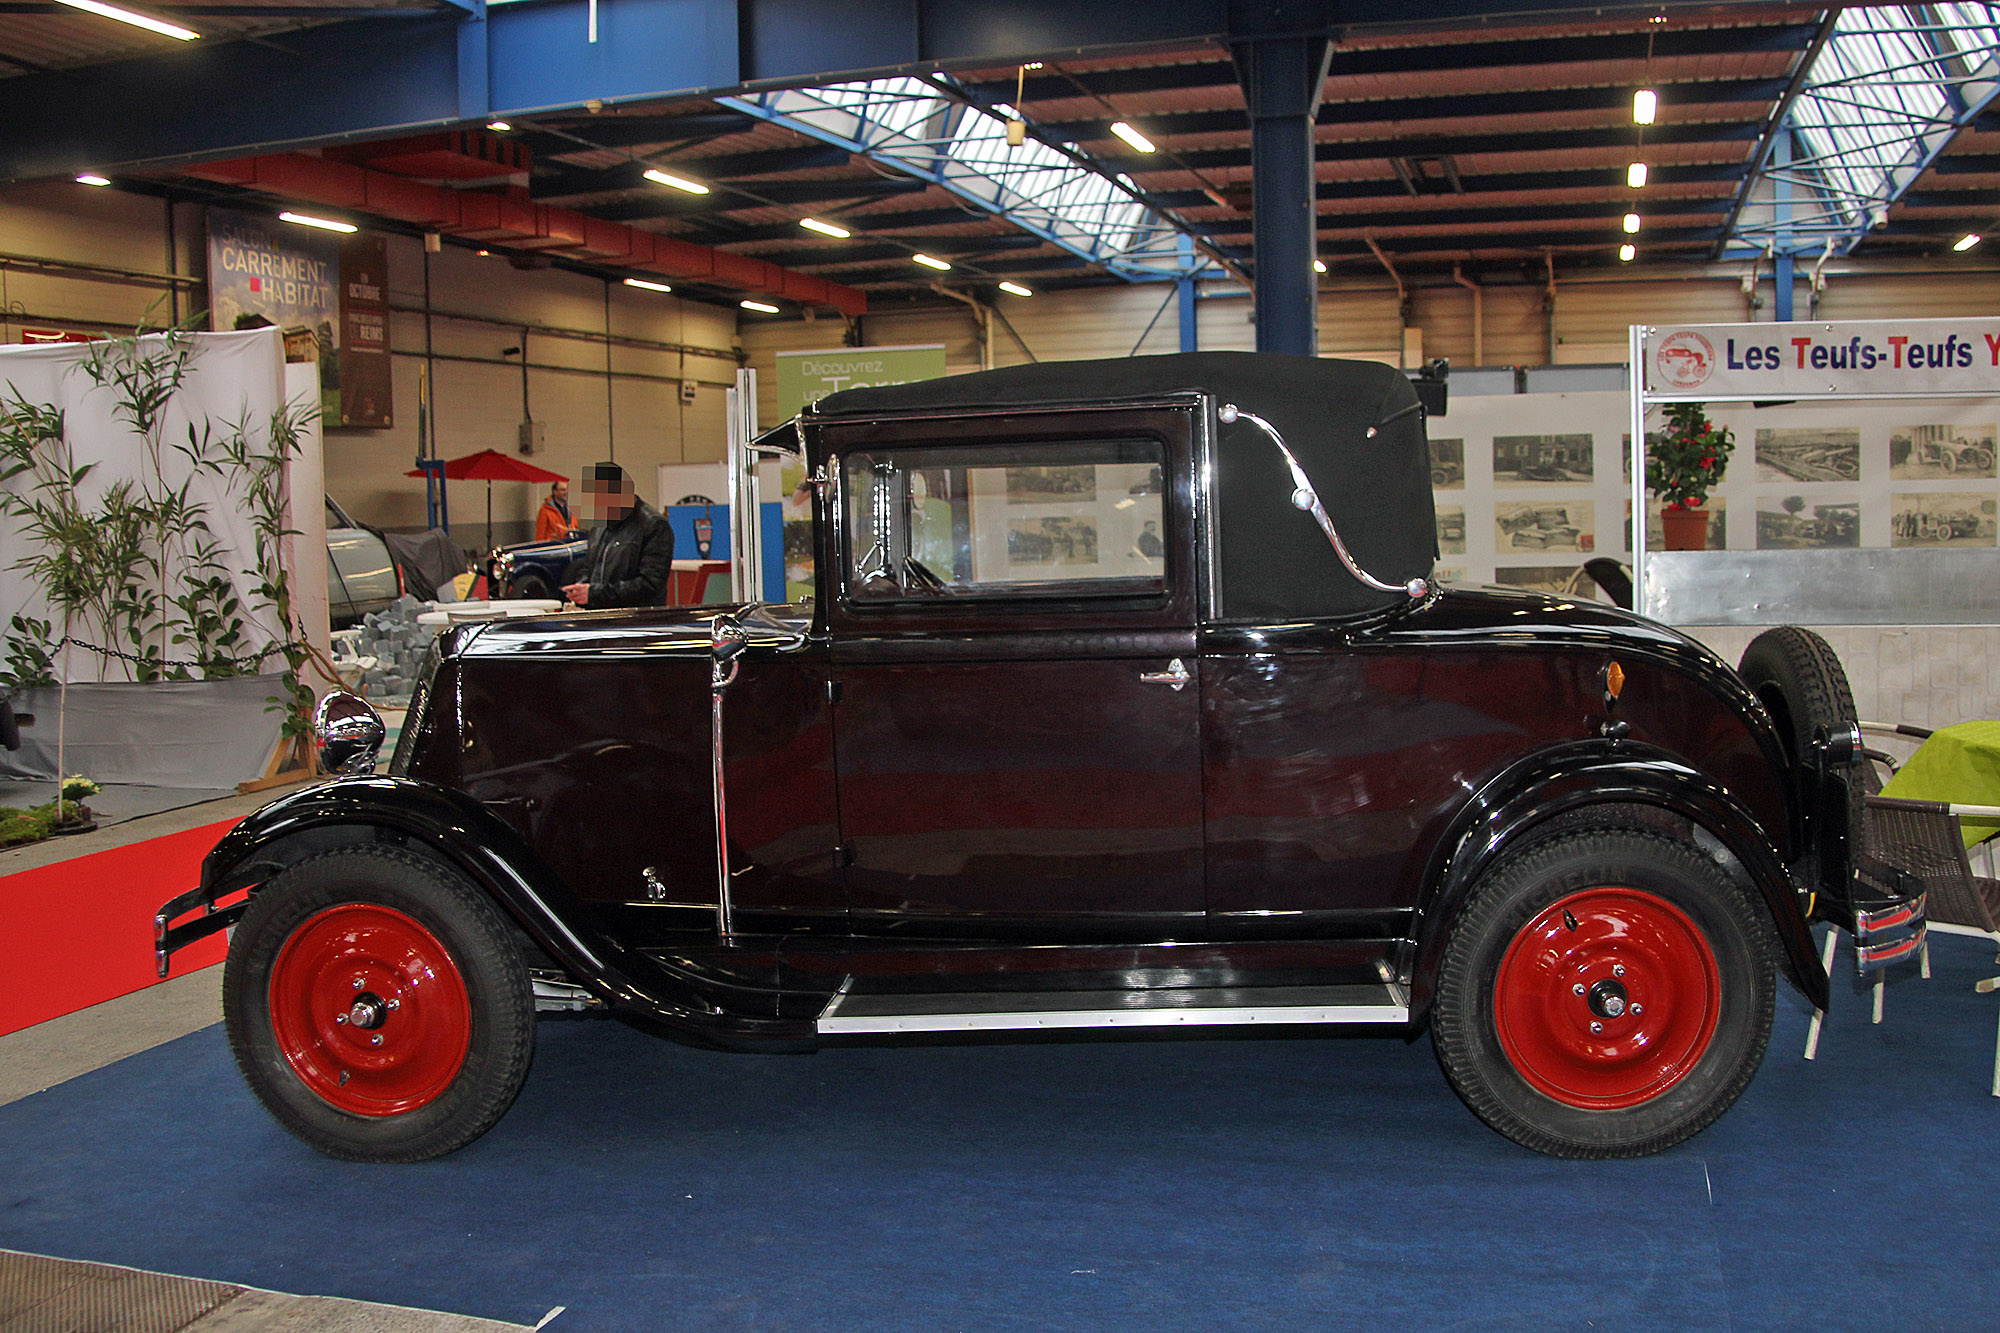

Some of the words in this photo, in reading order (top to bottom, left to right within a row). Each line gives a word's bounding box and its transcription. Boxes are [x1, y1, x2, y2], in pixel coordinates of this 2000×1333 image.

[222, 246, 327, 282] CARREMENT
[261, 277, 328, 308] HABITAT
[360, 324, 384, 342] REIMS
[1727, 339, 1780, 370] Les
[1791, 334, 1973, 369] Teufs-Teufs
[802, 360, 883, 376] Découvrez
